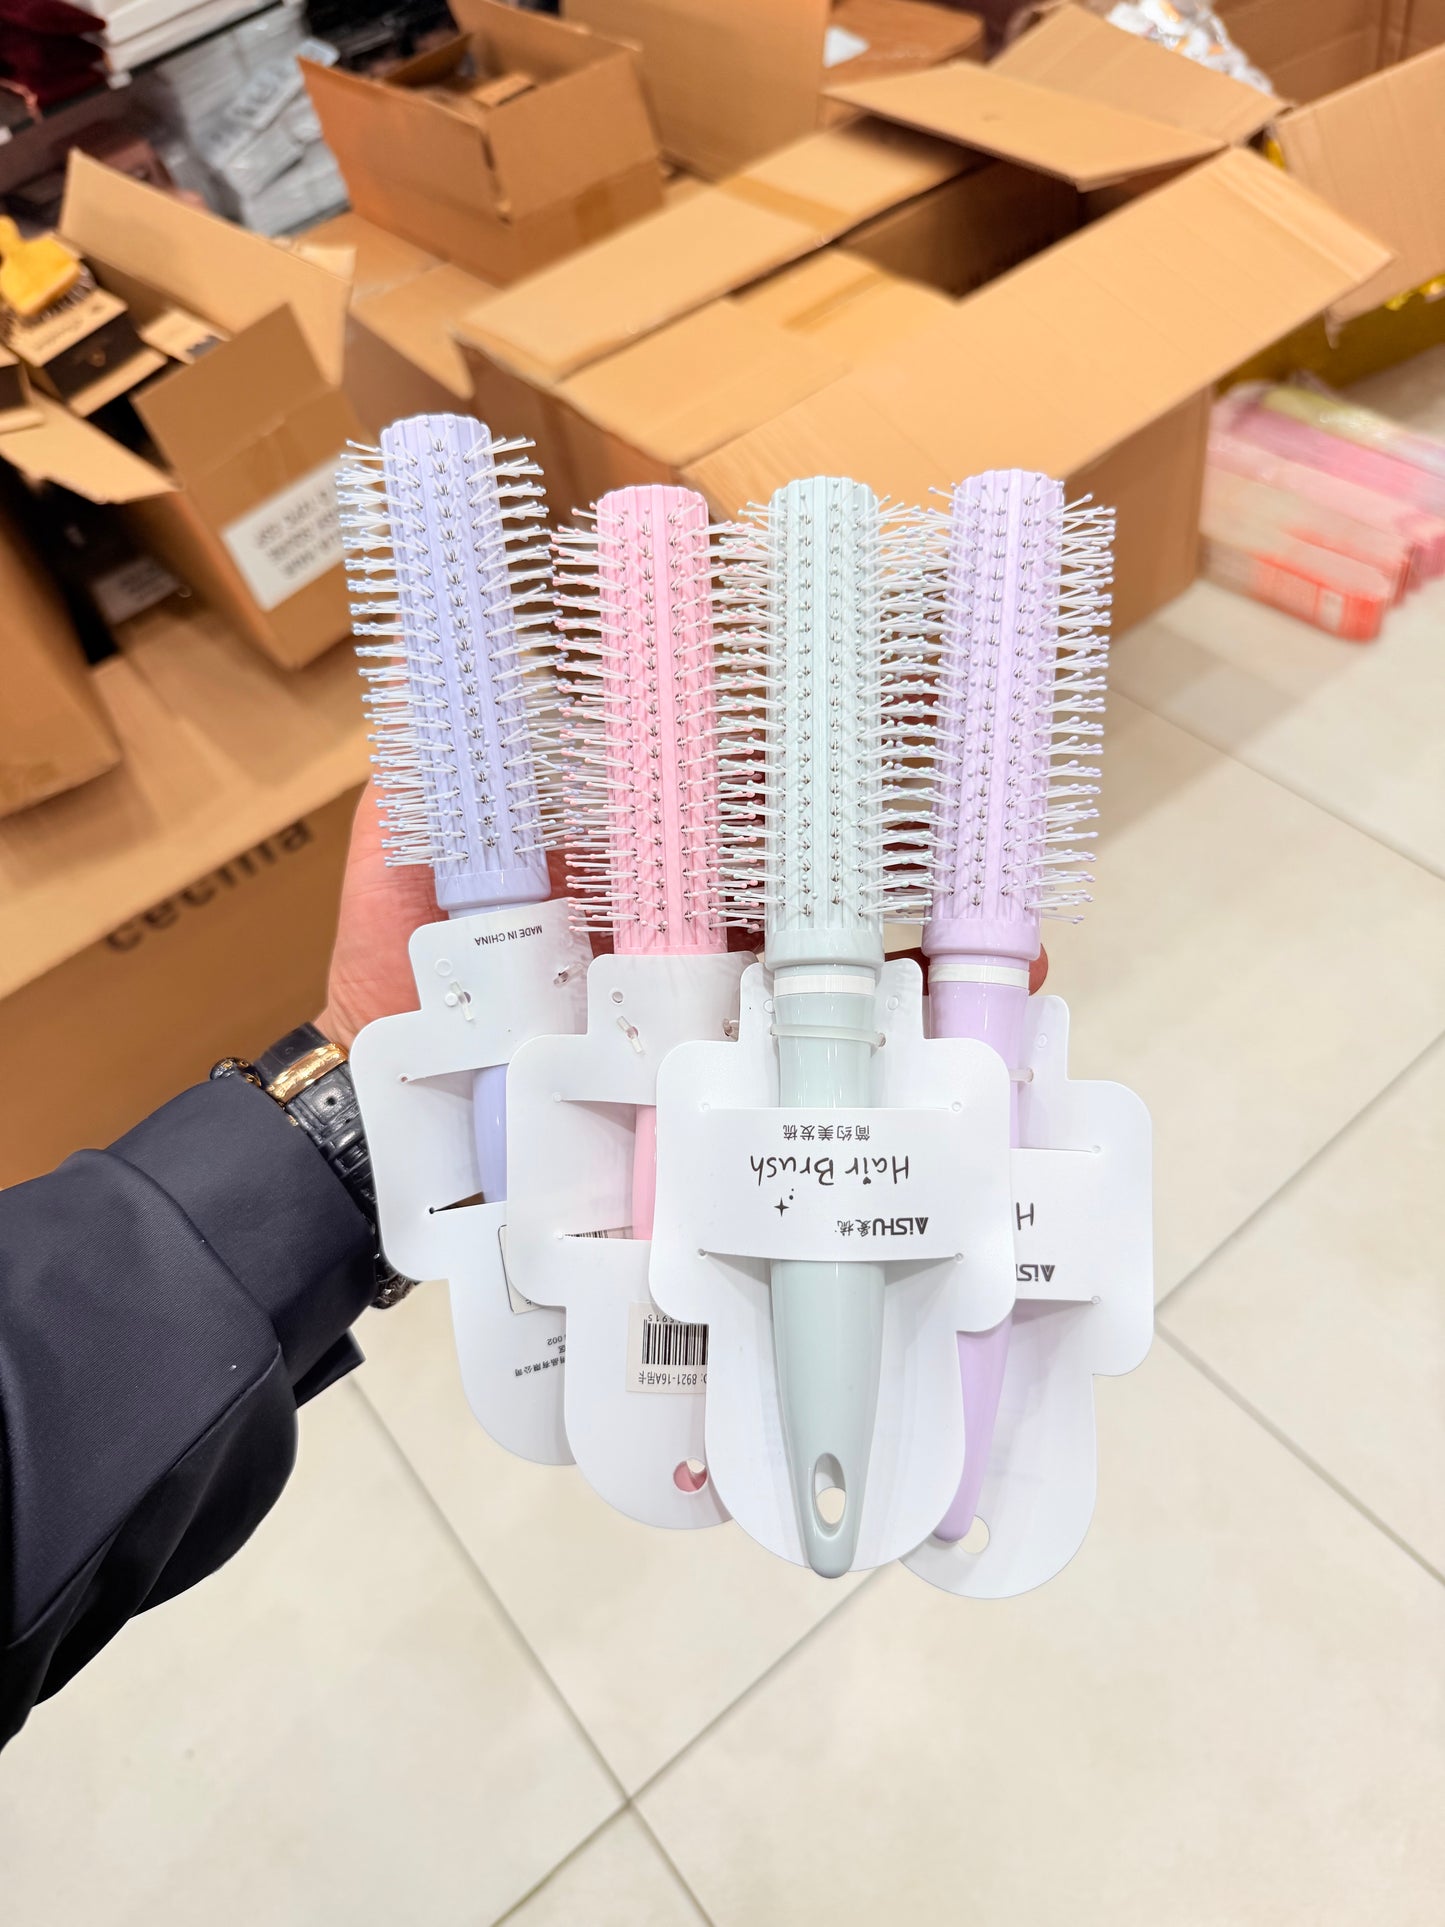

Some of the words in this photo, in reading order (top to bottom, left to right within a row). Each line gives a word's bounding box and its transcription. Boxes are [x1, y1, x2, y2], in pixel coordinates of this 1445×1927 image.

[507, 930, 518, 941] IN
[519, 924, 543, 938] MADE
[474, 932, 506, 946] CHINA
[783, 1124, 871, 1141] 简约美发梳
[750, 1155, 835, 1187] Brush
[845, 1155, 909, 1185] Hair
[1015, 1264, 1056, 1282] AiS
[648, 1314, 680, 1323] 5915
